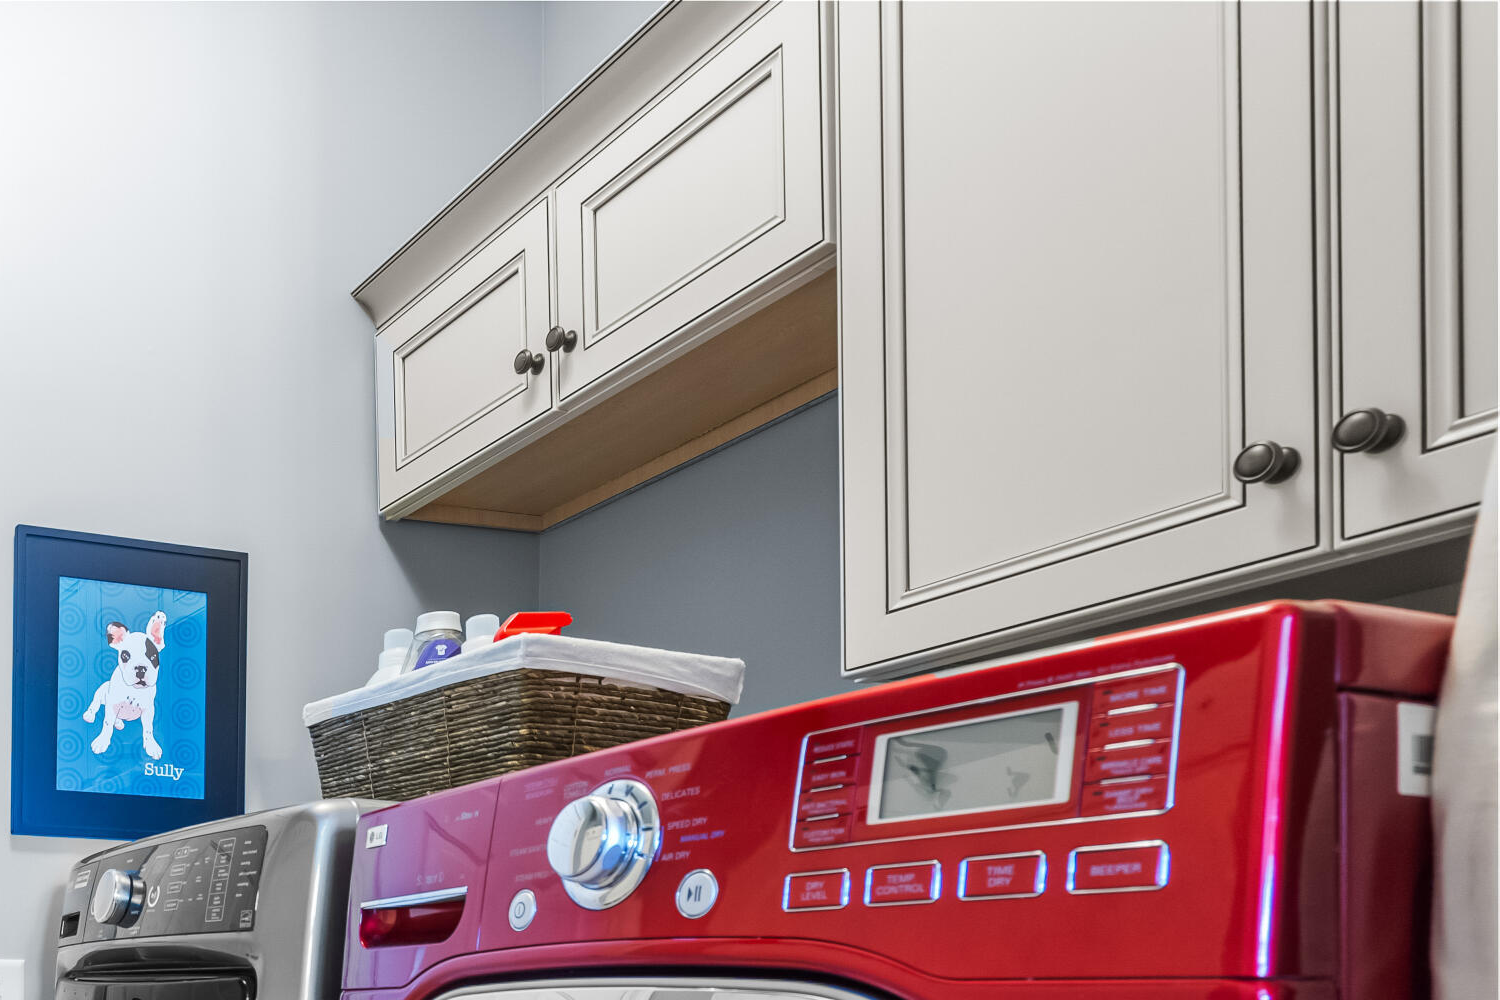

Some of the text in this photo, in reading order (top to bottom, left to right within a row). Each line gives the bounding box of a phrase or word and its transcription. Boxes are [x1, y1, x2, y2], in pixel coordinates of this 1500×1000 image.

[1143, 685, 1167, 697] TIME
[1137, 722, 1161, 732] TIME
[144, 762, 185, 781] Sully
[661, 786, 701, 801] DELICATES
[667, 816, 708, 831] SPEED DRY
[675, 851, 691, 860] DRY
[986, 864, 1014, 876] TIME
[1089, 862, 1142, 877] BEEPER
[887, 873, 915, 884] TEMP
[986, 876, 1012, 888] DRY
[804, 881, 825, 891] DRY
[875, 883, 924, 896] CONTROL
[801, 891, 827, 901] LEVEL
